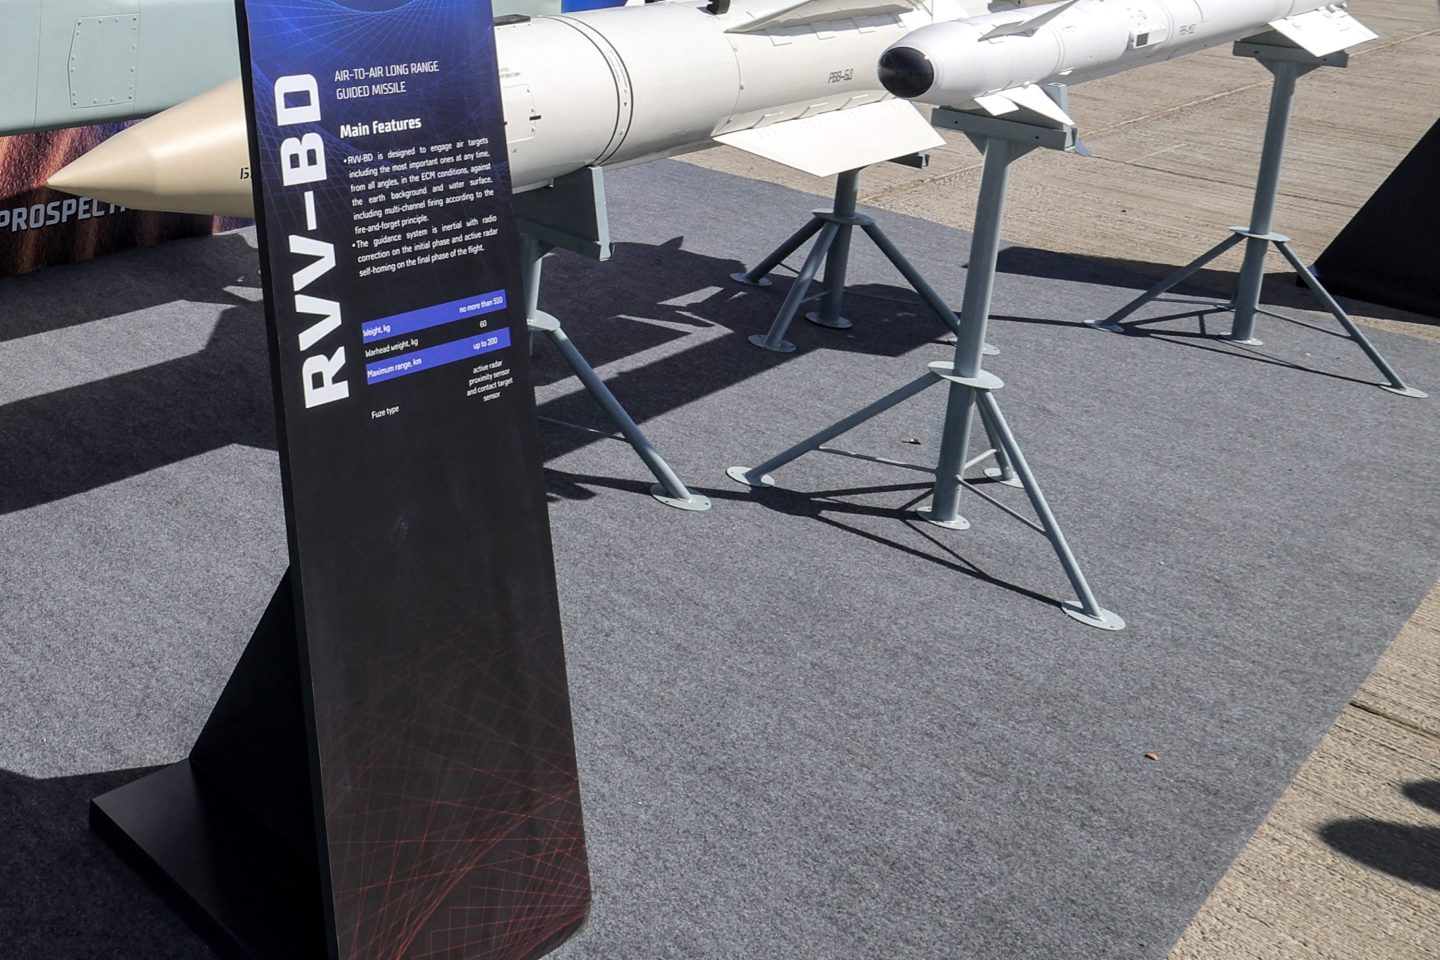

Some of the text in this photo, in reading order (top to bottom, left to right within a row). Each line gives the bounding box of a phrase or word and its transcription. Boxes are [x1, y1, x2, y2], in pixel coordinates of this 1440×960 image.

[334, 60, 439, 81] AIR-TO-AIR LONG RANGE
[336, 80, 406, 99] GUIDED MISSILE
[340, 118, 421, 138] Main Features
[347, 152, 373, 164] RVV-BD
[377, 151, 383, 159] is
[387, 146, 415, 158] designed
[430, 143, 452, 152] engage
[467, 137, 488, 146] targets
[351, 197, 362, 206] the
[368, 193, 385, 203] earth
[390, 186, 427, 199] background
[432, 183, 443, 192] and
[448, 181, 464, 189] water
[356, 214, 496, 248] The guidance system is inertial with radio
[274, 73, 350, 409] RVV-BD
[492, 296, 502, 304] 510
[382, 324, 390, 332] kg
[479, 319, 486, 327] 60
[364, 344, 390, 357] Warhead
[410, 338, 418, 346] kg
[486, 336, 497, 345] 200
[367, 365, 394, 377] Maximum
[371, 406, 398, 418] Fuze type
